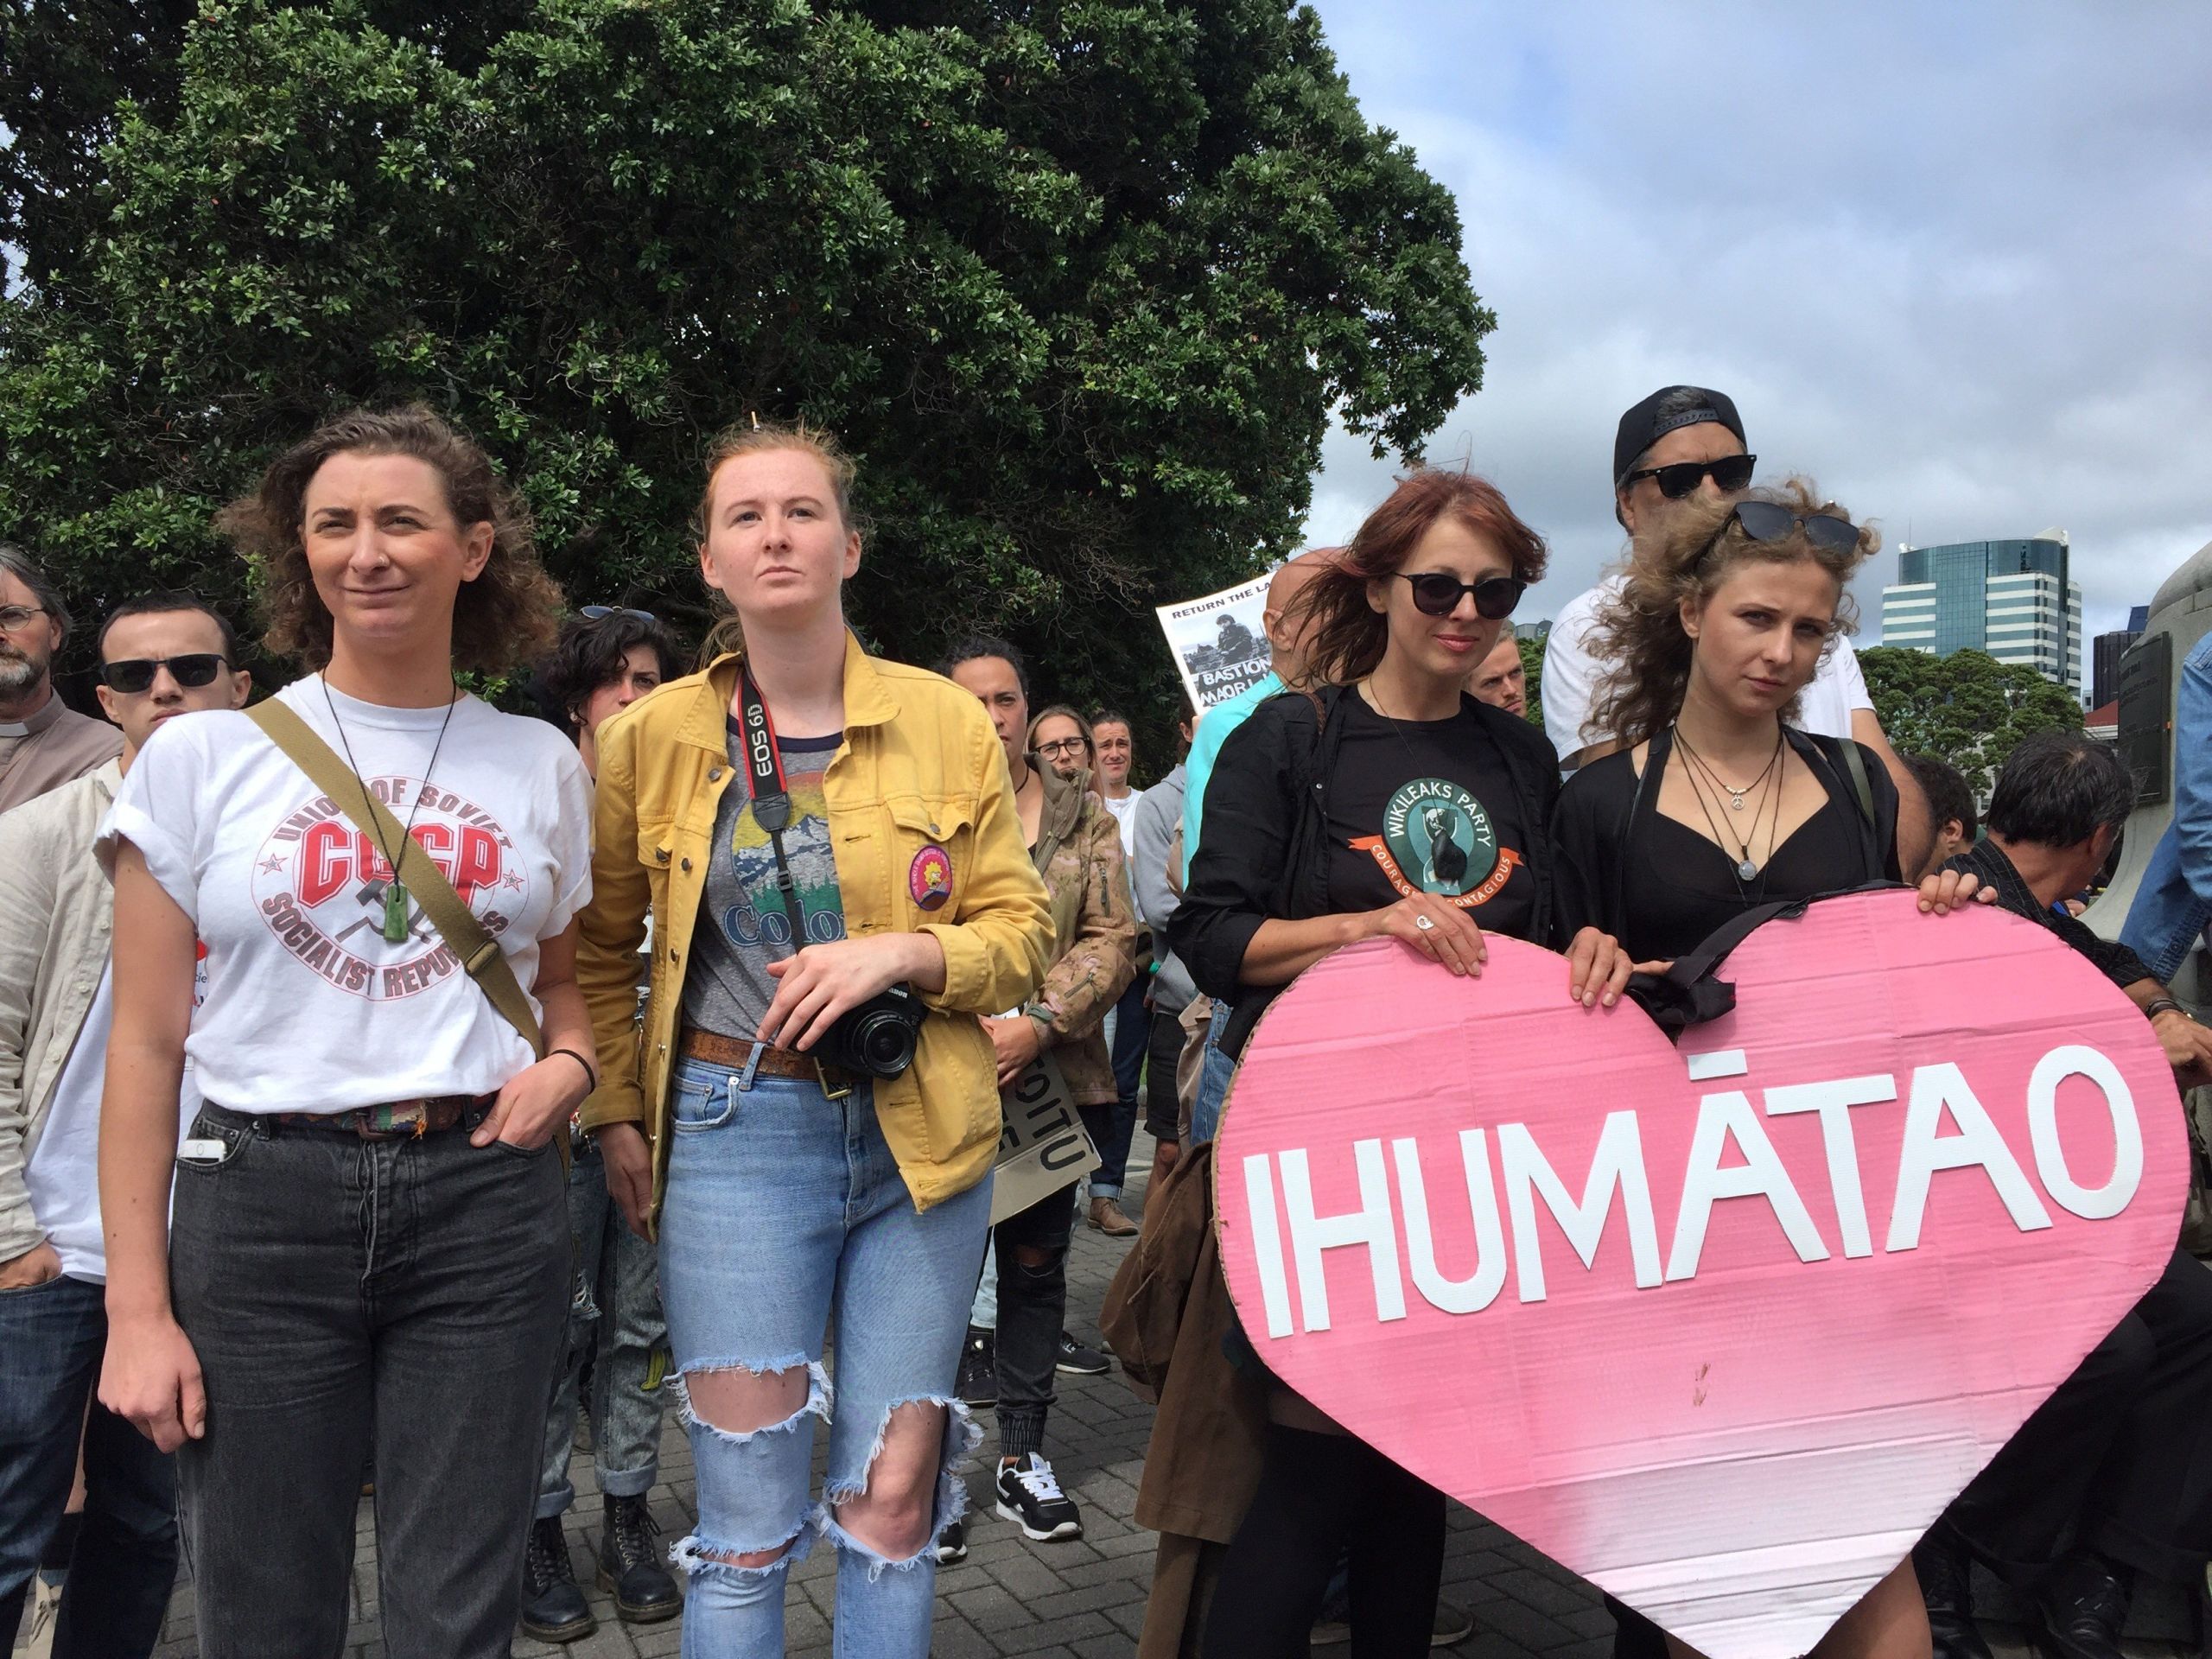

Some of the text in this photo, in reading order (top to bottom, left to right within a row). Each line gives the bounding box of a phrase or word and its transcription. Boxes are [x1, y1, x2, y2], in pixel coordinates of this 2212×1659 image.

[1173, 582, 1271, 620] RETURN THE LA
[1203, 656, 1273, 686] BASTION
[747, 704, 773, 777] EOS 6D
[272, 779, 513, 849] UNIO OF SOVIET
[1388, 781, 1491, 849] WIKILEAKS PARTY
[262, 892, 376, 996] SOCIALIST
[888, 988, 908, 999] anon
[1243, 1044, 2144, 1340] IHUMĀTAO
